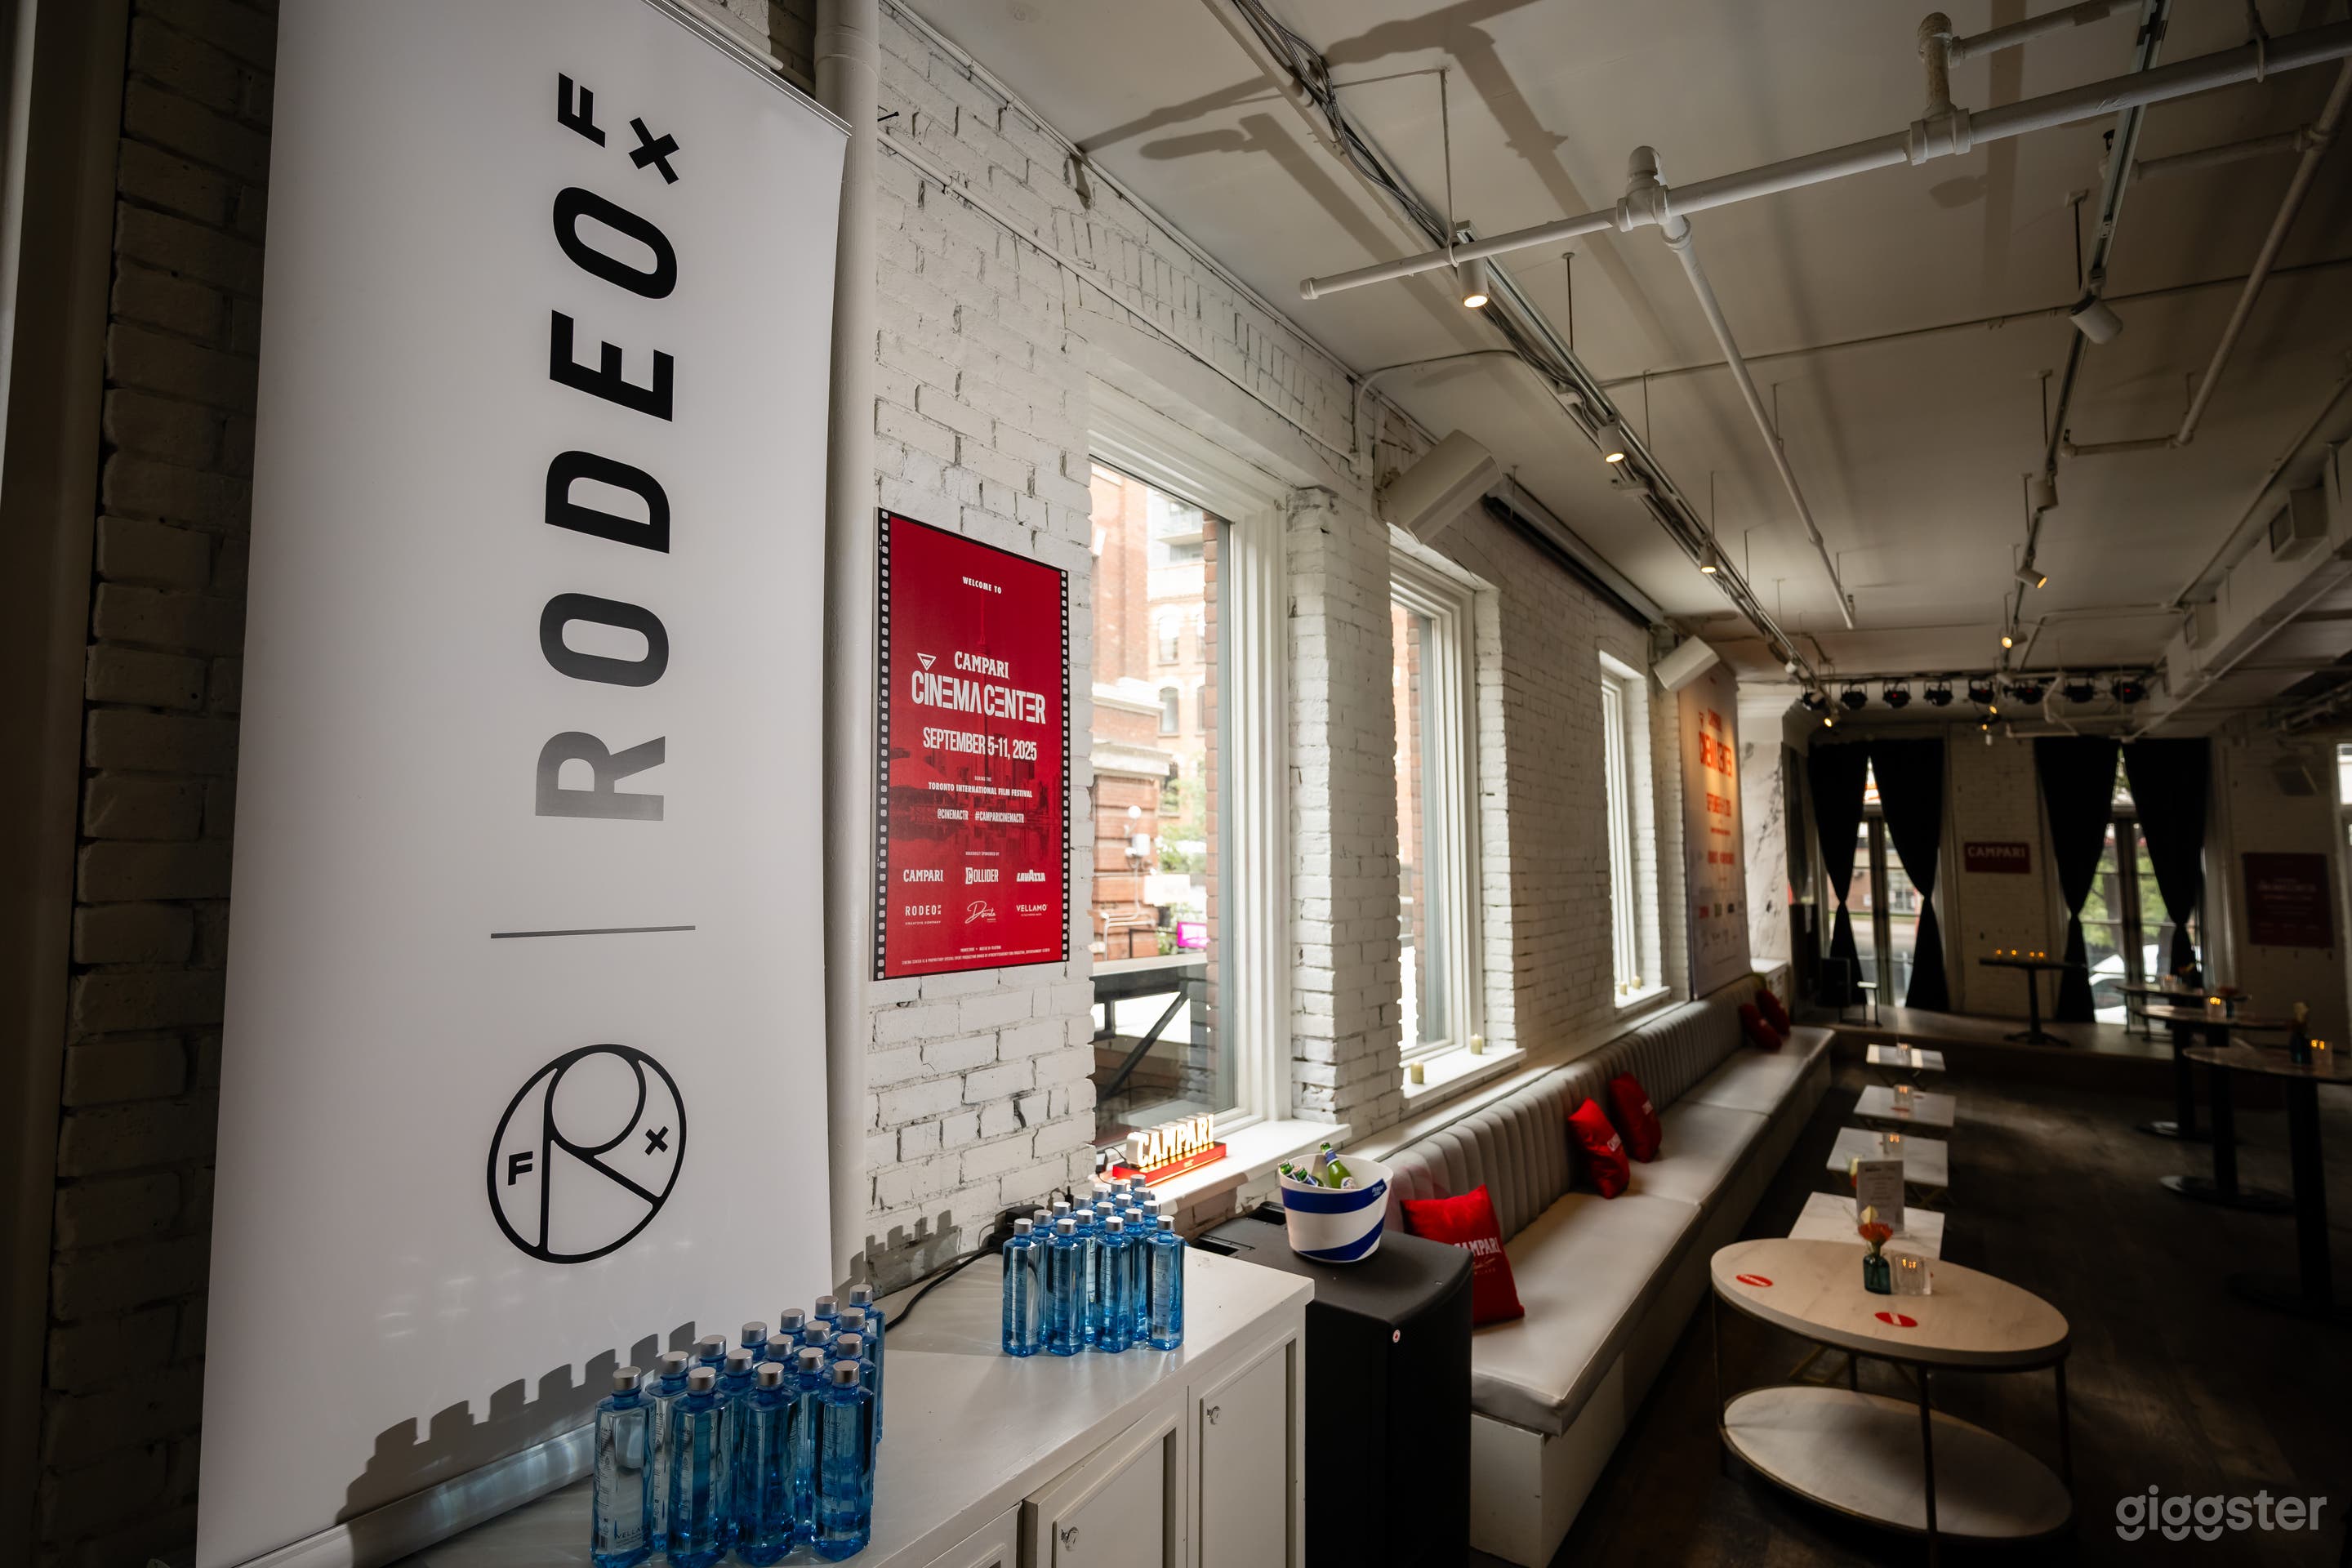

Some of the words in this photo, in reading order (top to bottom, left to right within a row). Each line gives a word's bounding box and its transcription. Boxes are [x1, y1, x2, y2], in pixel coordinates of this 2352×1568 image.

[963, 576, 991, 591] WELCOME
[994, 586, 1001, 594] TO
[955, 651, 1009, 679] CAMPARI
[911, 670, 982, 714] CINEMA
[983, 684, 1046, 724] CENTER
[923, 727, 986, 755] SEPTEMBER
[987, 737, 1010, 760] 5-11,
[1013, 739, 1036, 761] 2025
[929, 782, 955, 791] TORONTO
[956, 784, 997, 795] INTERNATIONAL
[998, 787, 1010, 796] FILM
[1011, 789, 1032, 798] FESTIVAL
[938, 808, 969, 820] @CINEMACTR
[975, 811, 1025, 823] #CAMPARICINEMACTR
[1967, 846, 2026, 859] CAMPARI
[903, 869, 944, 882] CAMPARI
[965, 866, 998, 884] COLLIDER
[1016, 869, 1045, 882] LAVAZZA
[1016, 904, 1048, 912] VELLAMO
[1135, 1113, 1214, 1168] CAMPARI
